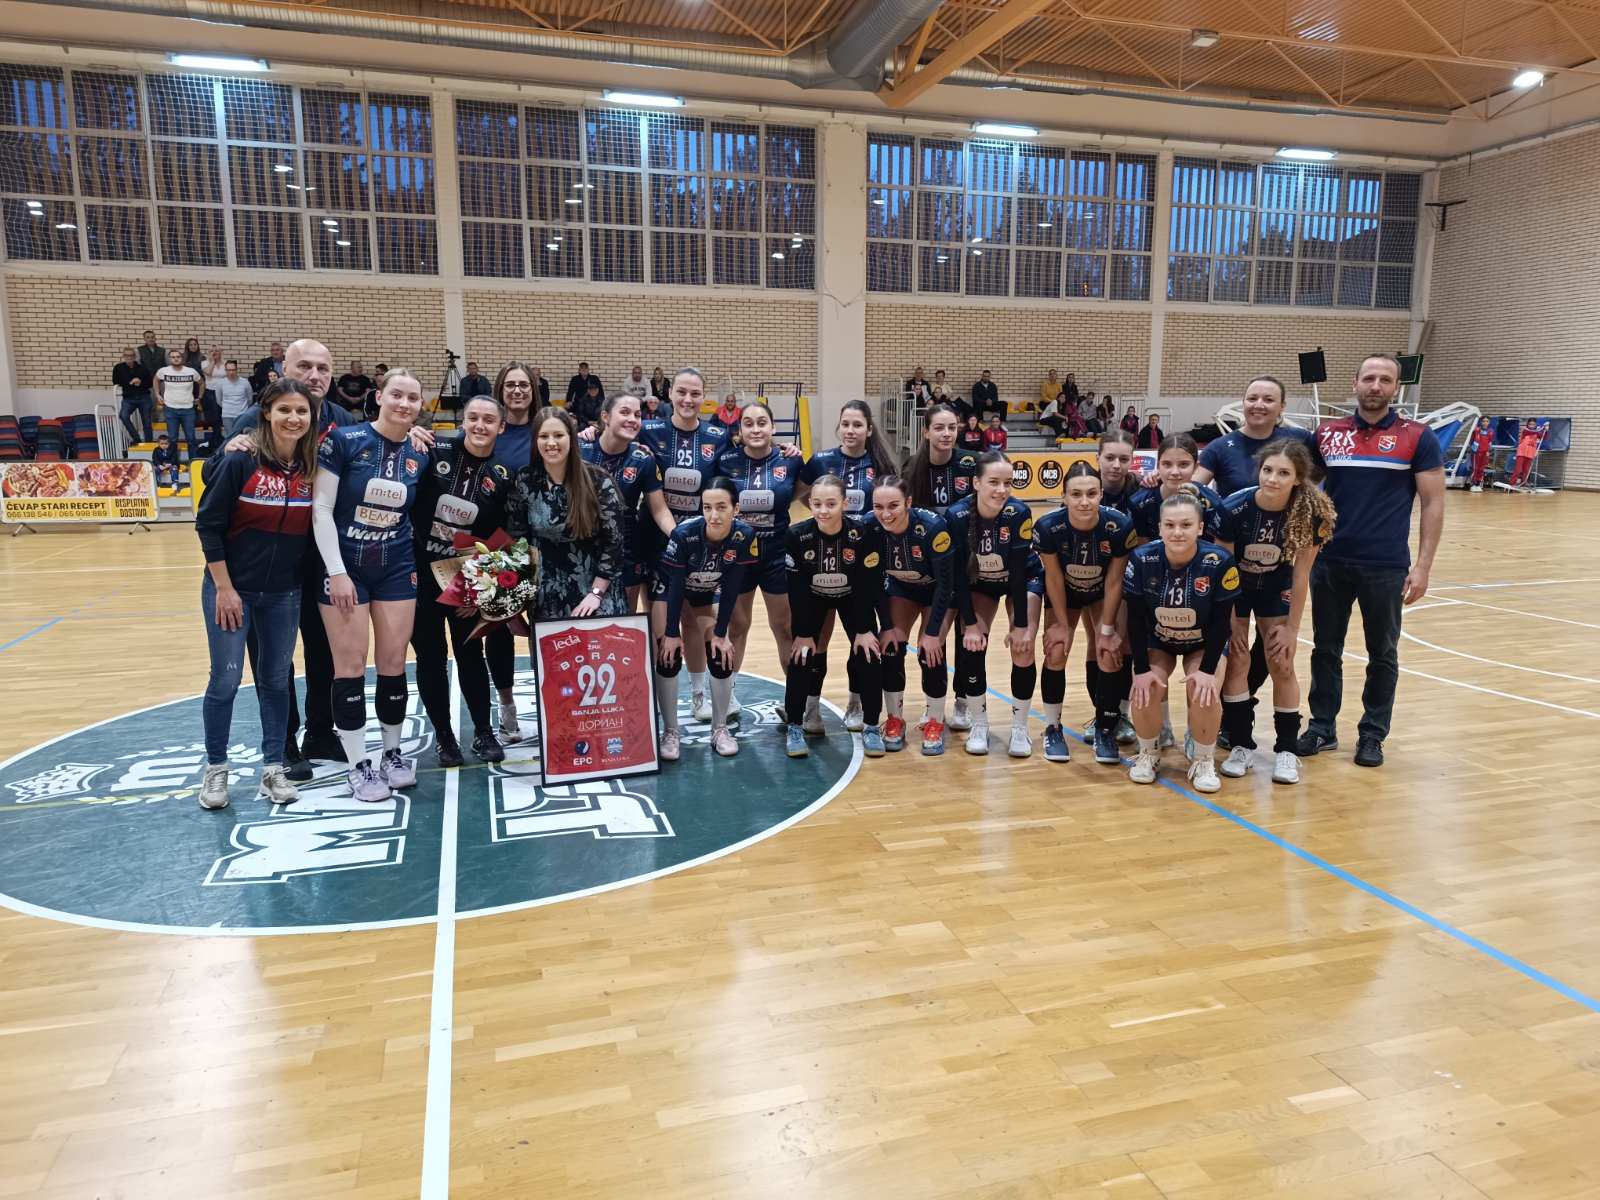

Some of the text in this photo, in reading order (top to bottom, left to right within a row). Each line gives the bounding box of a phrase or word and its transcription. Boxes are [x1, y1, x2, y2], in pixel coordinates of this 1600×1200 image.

[1320, 426, 1358, 448] ŽRK
[677, 449, 693, 467] 25
[385, 460, 394, 478] 8
[1043, 469, 1058, 480] MCB
[462, 480, 470, 496] 1
[668, 475, 697, 487] m:tel
[753, 475, 762, 489] 4
[847, 474, 854, 488] 3
[371, 486, 403, 501] m:tel
[742, 495, 770, 505] m:tel
[934, 487, 948, 504] 16
[6, 500, 106, 511] ČEVAP STARI RECEPT
[440, 503, 473, 520] m:tel
[360, 507, 399, 523] BEMA
[1258, 529, 1274, 542] 34
[980, 538, 992, 553] 18
[823, 557, 836, 571] 12
[894, 557, 902, 569] 6
[1081, 551, 1088, 565] 7
[1168, 587, 1184, 606] 13
[1160, 614, 1192, 623] m:tel
[552, 634, 582, 651] leda
[560, 651, 632, 671] BORAC
[577, 663, 617, 707] 22
[571, 706, 625, 717] BANJA LUKA
[573, 757, 593, 766] EPC
